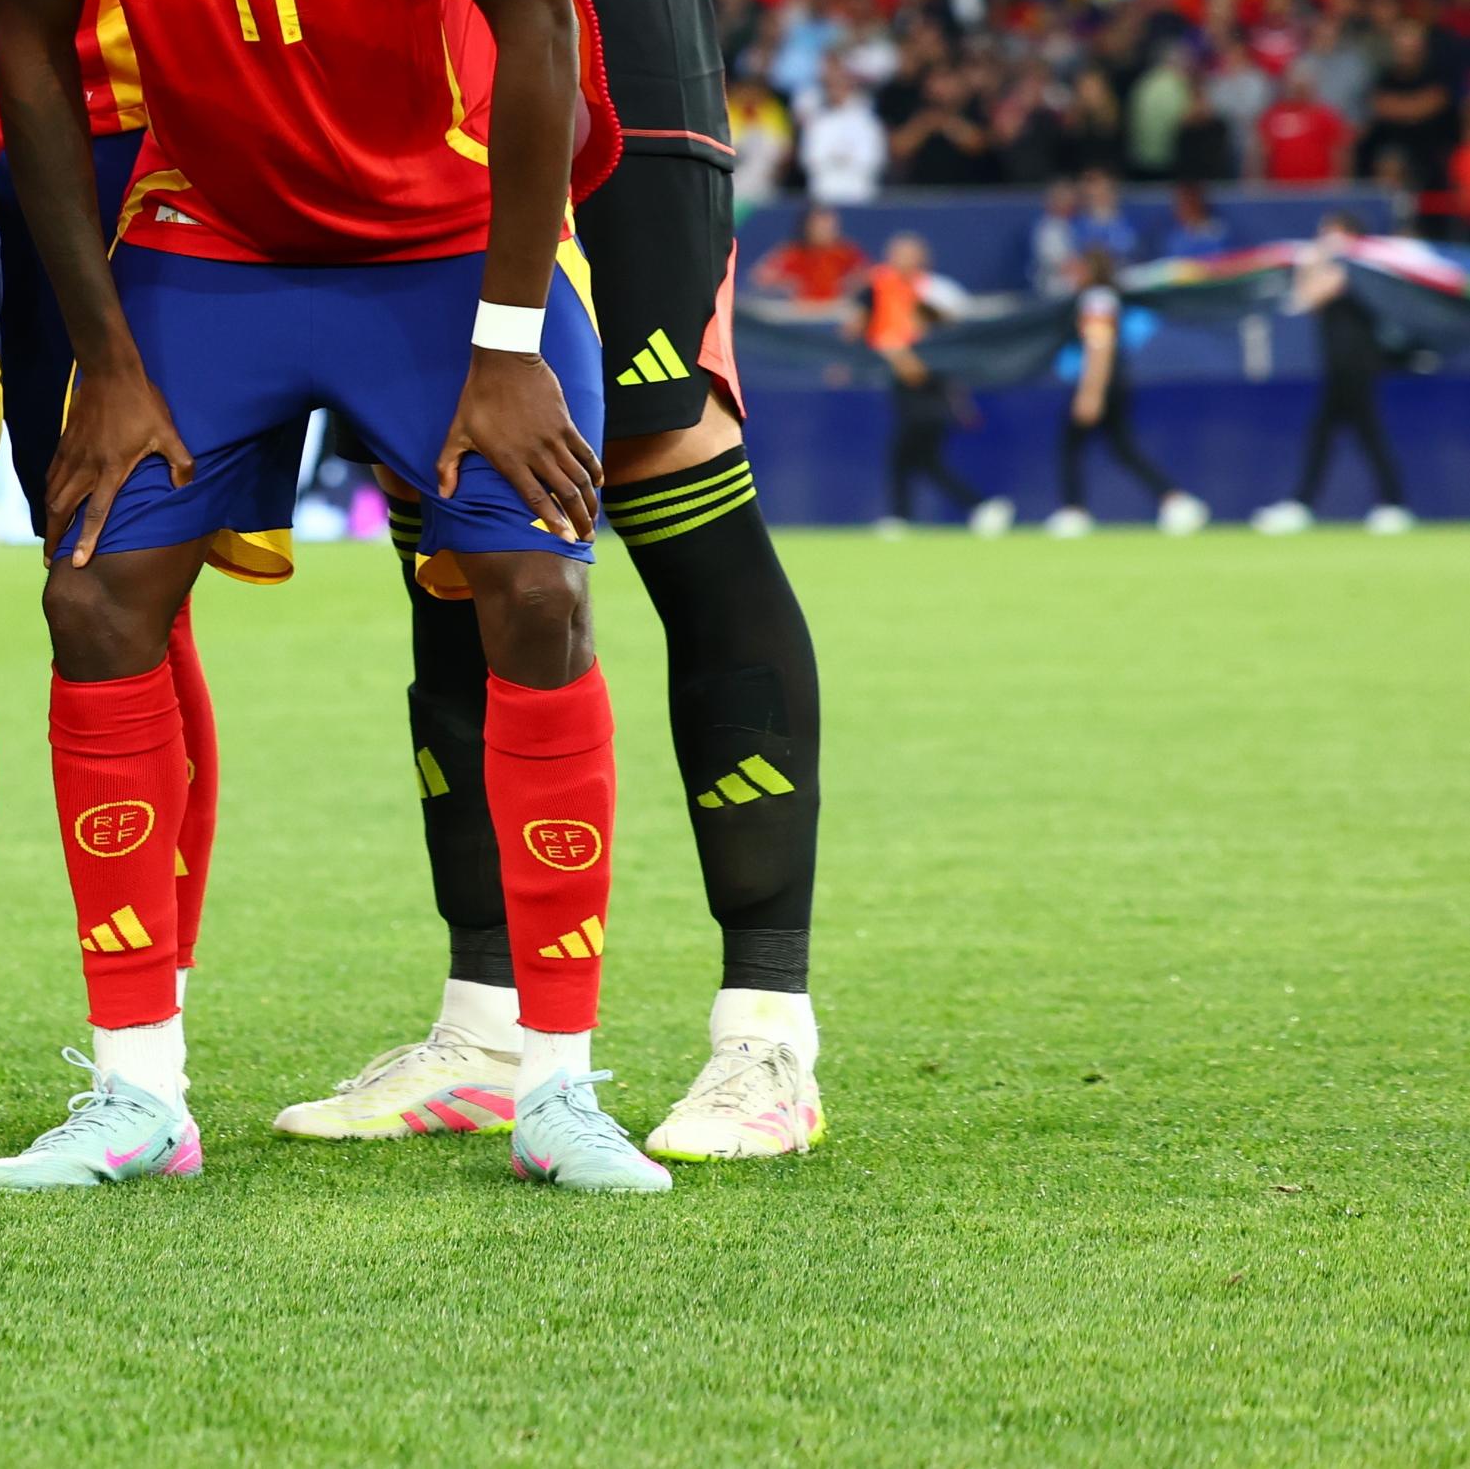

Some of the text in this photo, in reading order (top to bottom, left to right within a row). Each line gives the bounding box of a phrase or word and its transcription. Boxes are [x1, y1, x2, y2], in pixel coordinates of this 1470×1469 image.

[93, 811, 138, 829] RF
[93, 827, 136, 845] EF
[538, 830, 583, 843] RF
[545, 844, 586, 858] EF
